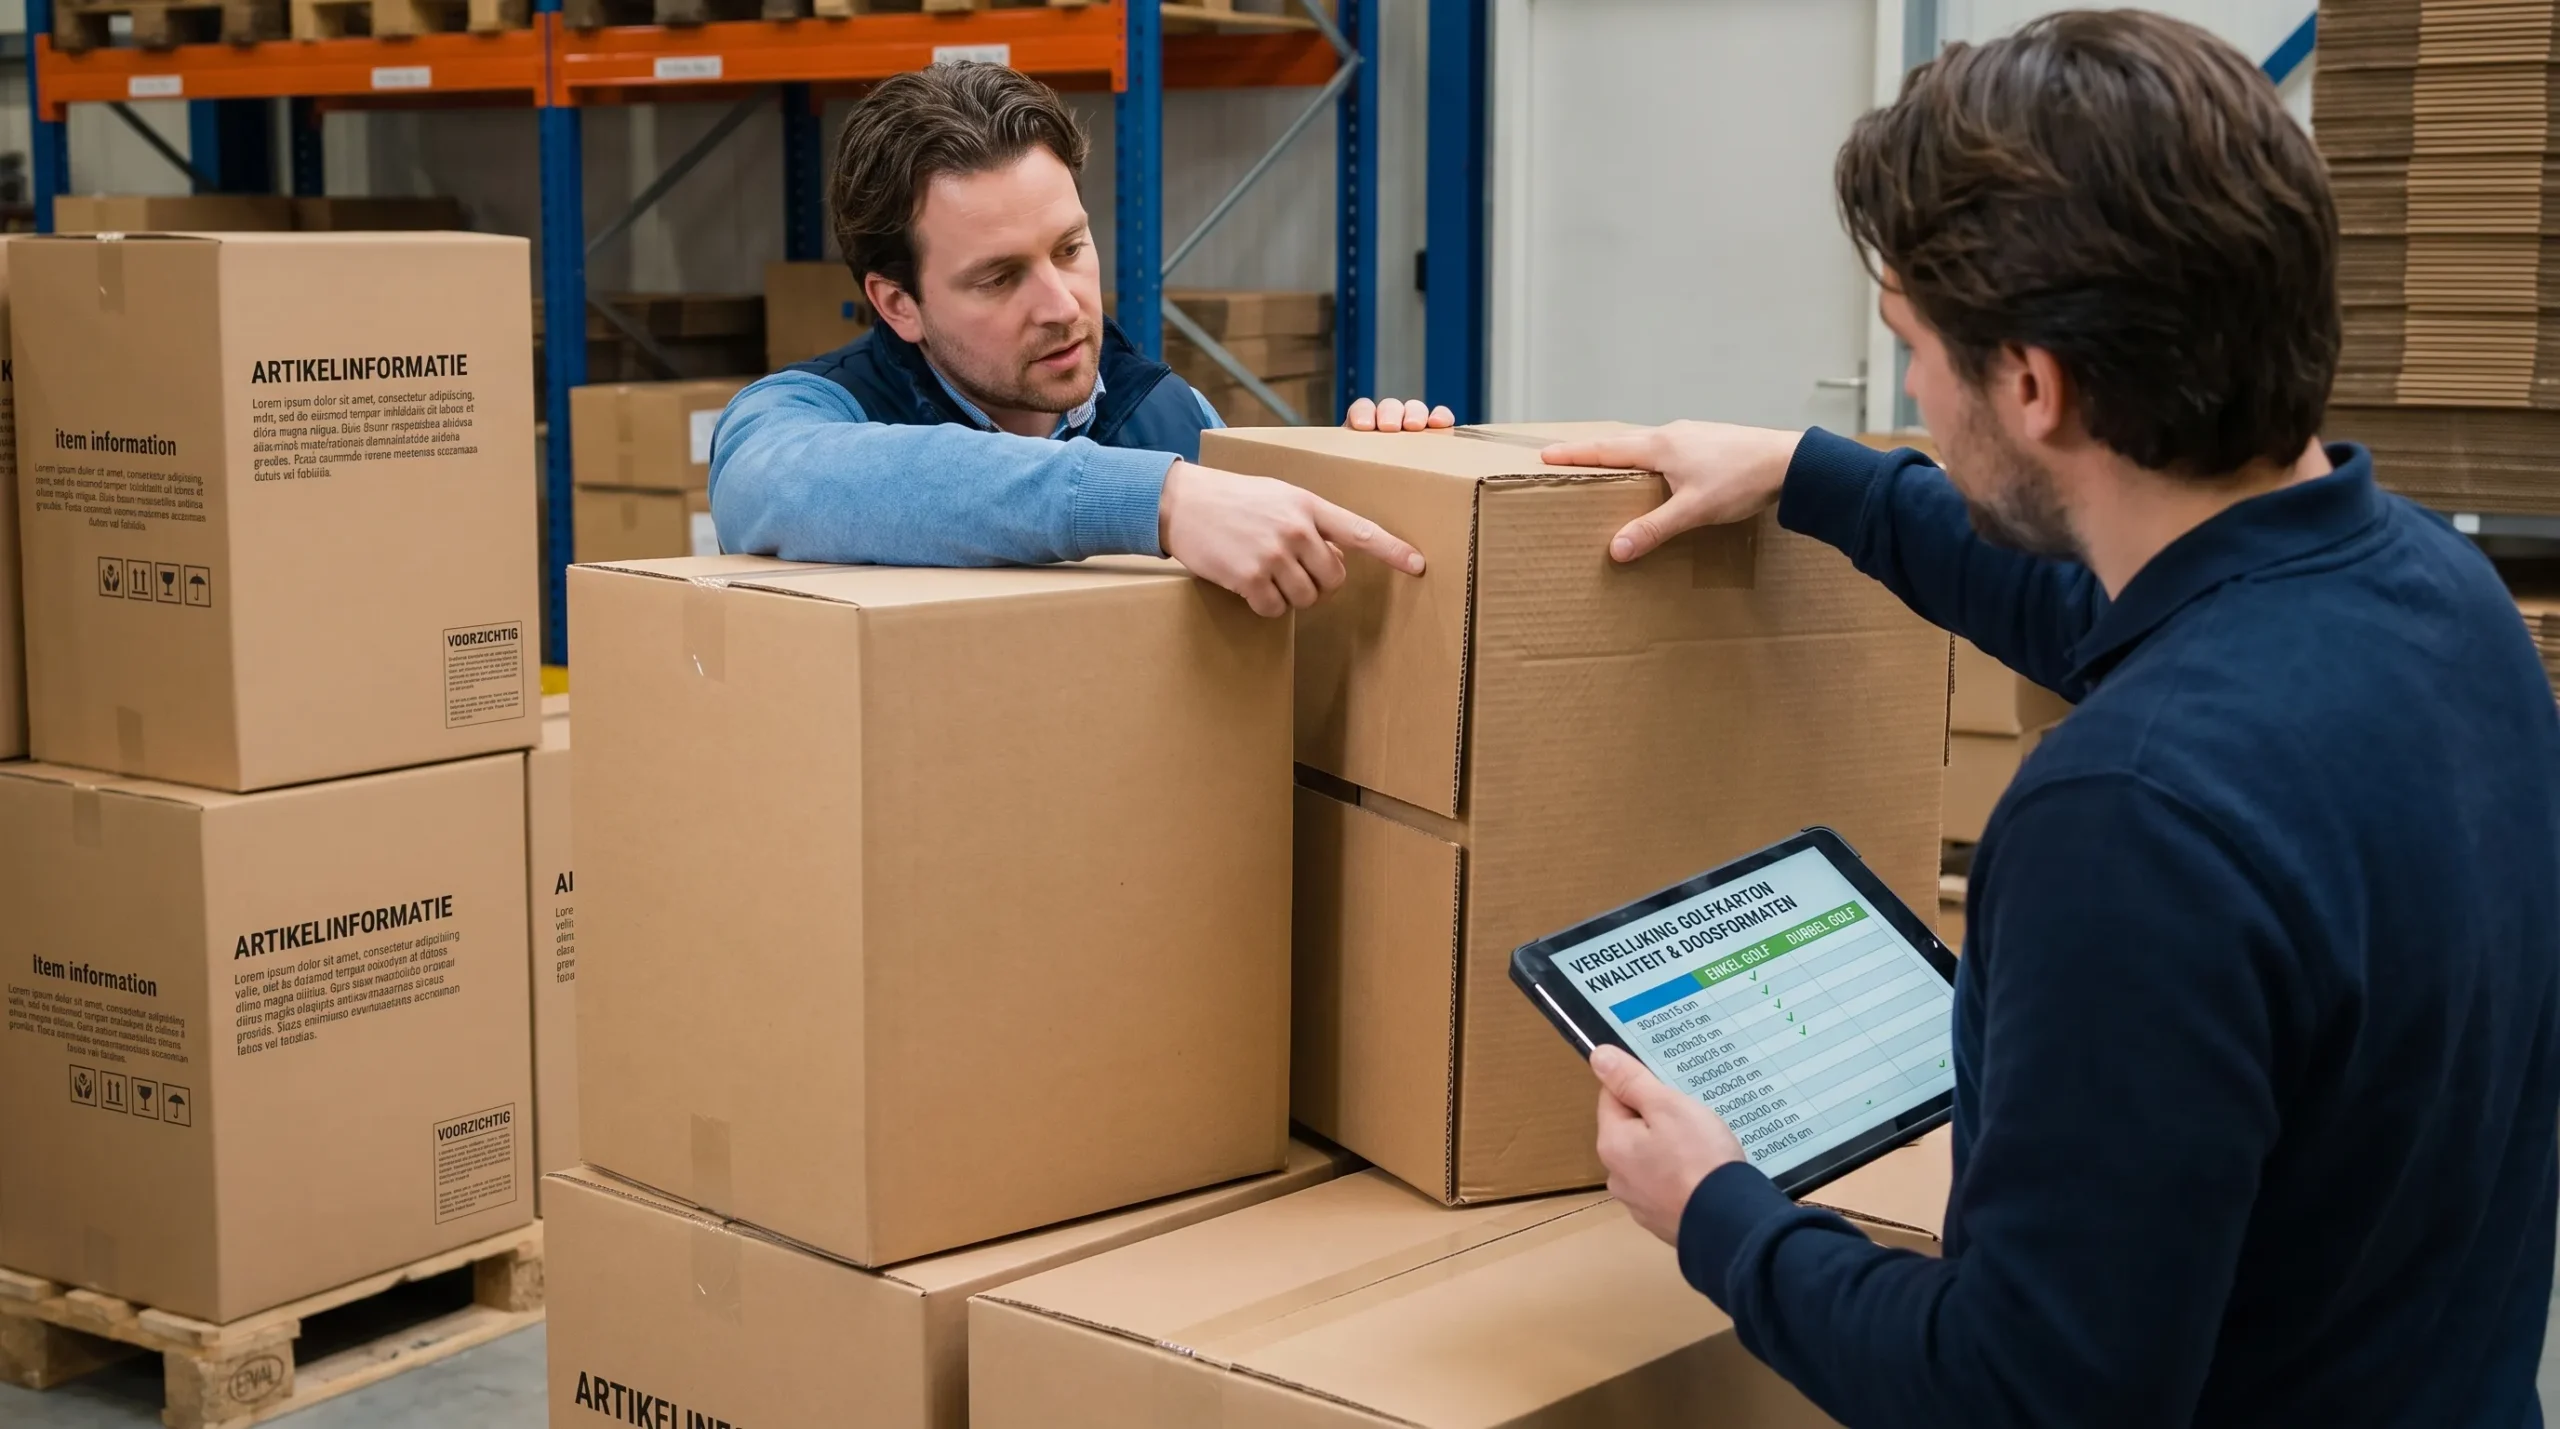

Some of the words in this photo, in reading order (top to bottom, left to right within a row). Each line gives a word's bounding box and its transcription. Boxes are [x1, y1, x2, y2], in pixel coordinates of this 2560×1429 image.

[252, 353, 468, 384] ARTIKELINFORMATIE
[252, 399, 281, 409] Lorem
[284, 397, 311, 410] ipsum
[313, 395, 336, 406] dolor
[339, 394, 350, 406] sit
[351, 395, 375, 405] amet,
[378, 393, 426, 403] consectetur
[279, 411, 294, 423] sed
[466, 402, 474, 413] et
[55, 428, 87, 450] item
[91, 430, 177, 456] information
[447, 627, 518, 648] VOORZICHTIG
[1827, 906, 1856, 926] GOLF
[234, 894, 453, 960] ARTIKELINFORMATIE
[1569, 921, 1679, 974] VERGELIJKING
[1677, 881, 1775, 930] GOLFKARTON
[1585, 949, 1667, 993] KWALITEIT
[1668, 944, 1683, 959] &
[1678, 894, 1798, 953] DOOSFORMATEN
[234, 971, 264, 985] Lorem
[267, 965, 295, 980] ipsum
[297, 959, 320, 972] dolor
[323, 955, 334, 967] sit
[1704, 957, 1743, 981] ENKEL
[1741, 944, 1770, 965] GOLF
[69, 960, 157, 997] information
[263, 994, 294, 1007] magna
[1683, 1000, 1698, 1011] cm
[1695, 1014, 1711, 1025] cm
[1707, 1028, 1722, 1039] cm
[1720, 1042, 1735, 1053] cm
[1733, 1055, 1749, 1066] cm
[1746, 1069, 1762, 1080] cm
[1759, 1084, 1774, 1096] cm
[1771, 1098, 1787, 1110] cm
[437, 1110, 511, 1141] VOORZICHTIG
